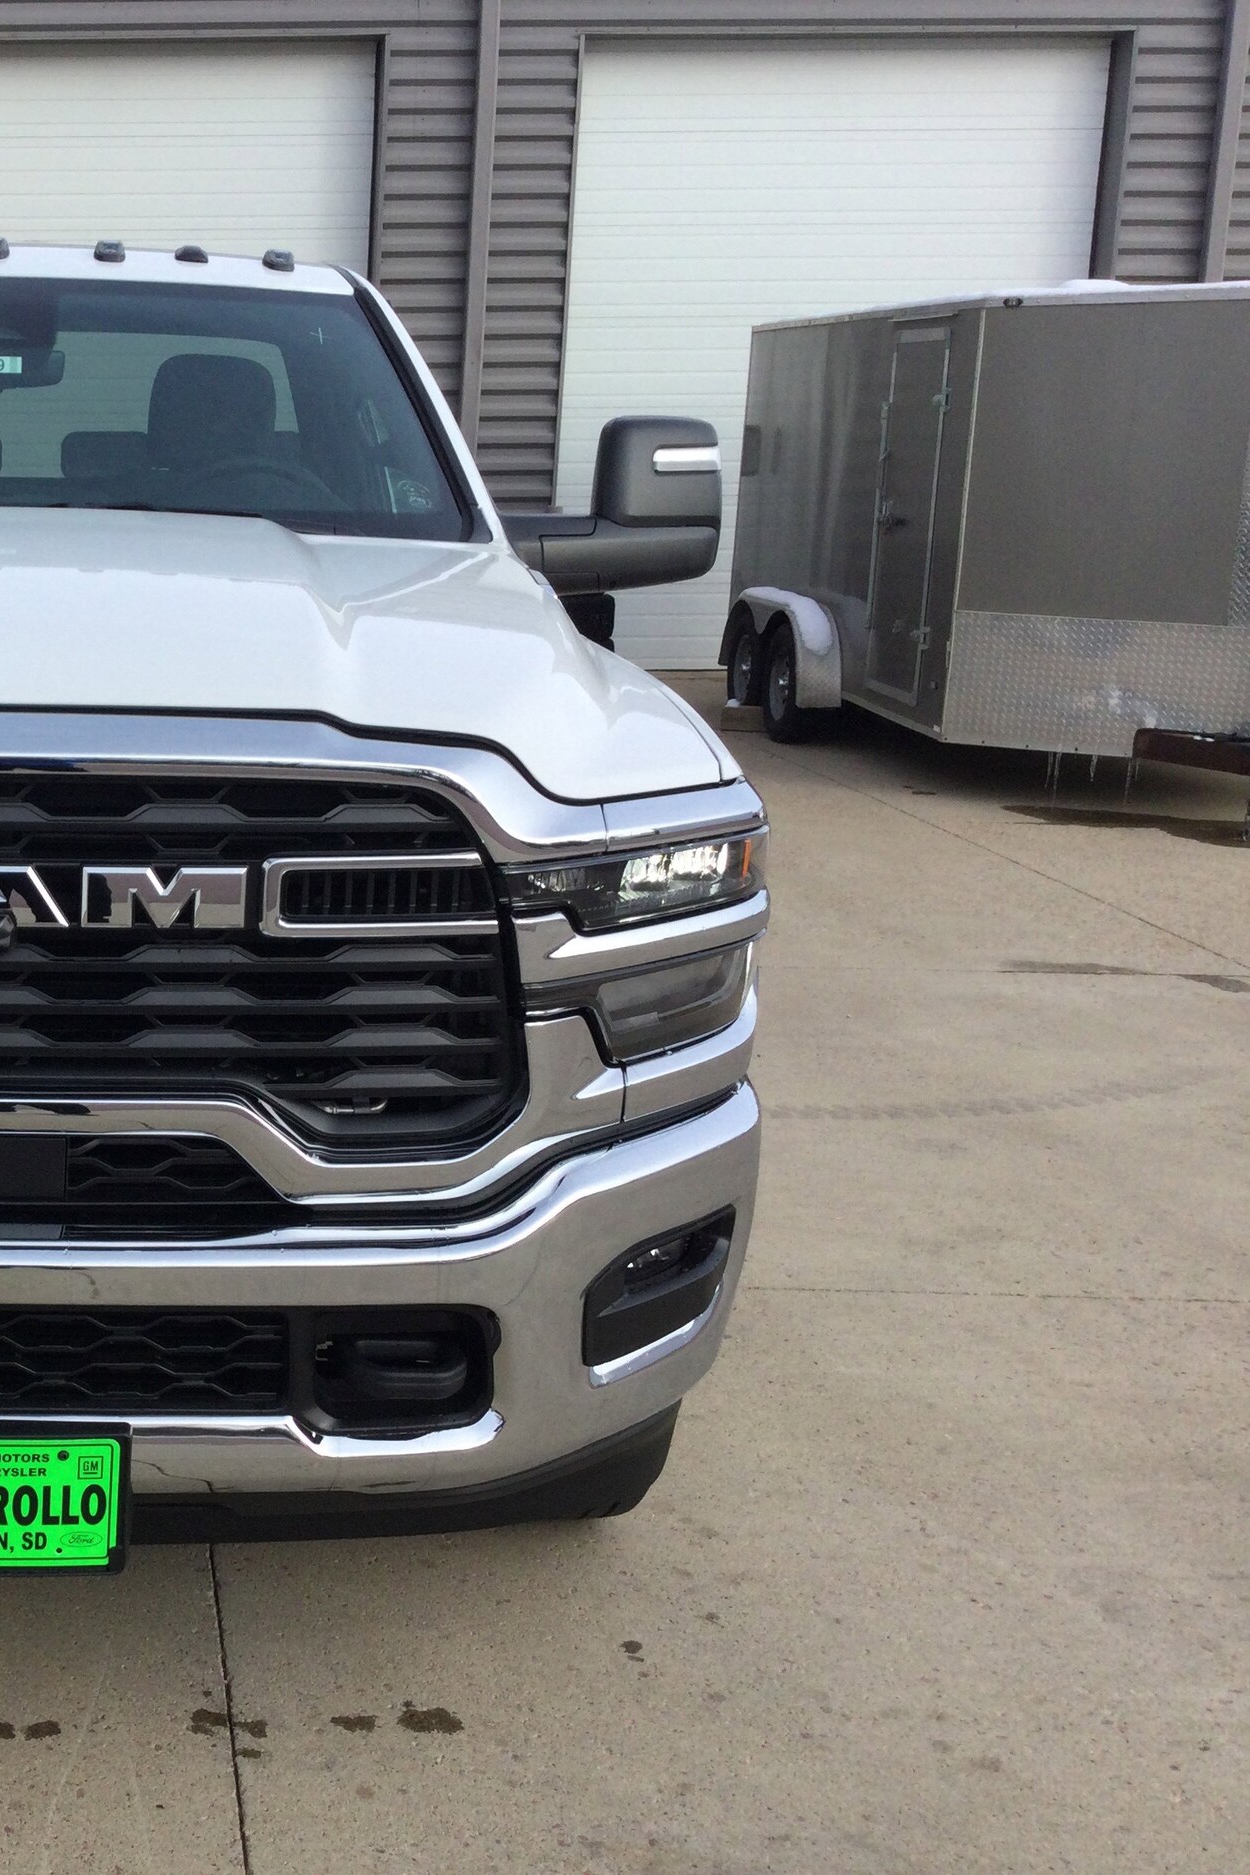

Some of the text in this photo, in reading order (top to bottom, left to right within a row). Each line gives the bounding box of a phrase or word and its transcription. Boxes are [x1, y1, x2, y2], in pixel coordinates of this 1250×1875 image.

[82, 1460, 99, 1471] GM
[21, 1532, 48, 1550] SD
[68, 1534, 95, 1544] Ford
